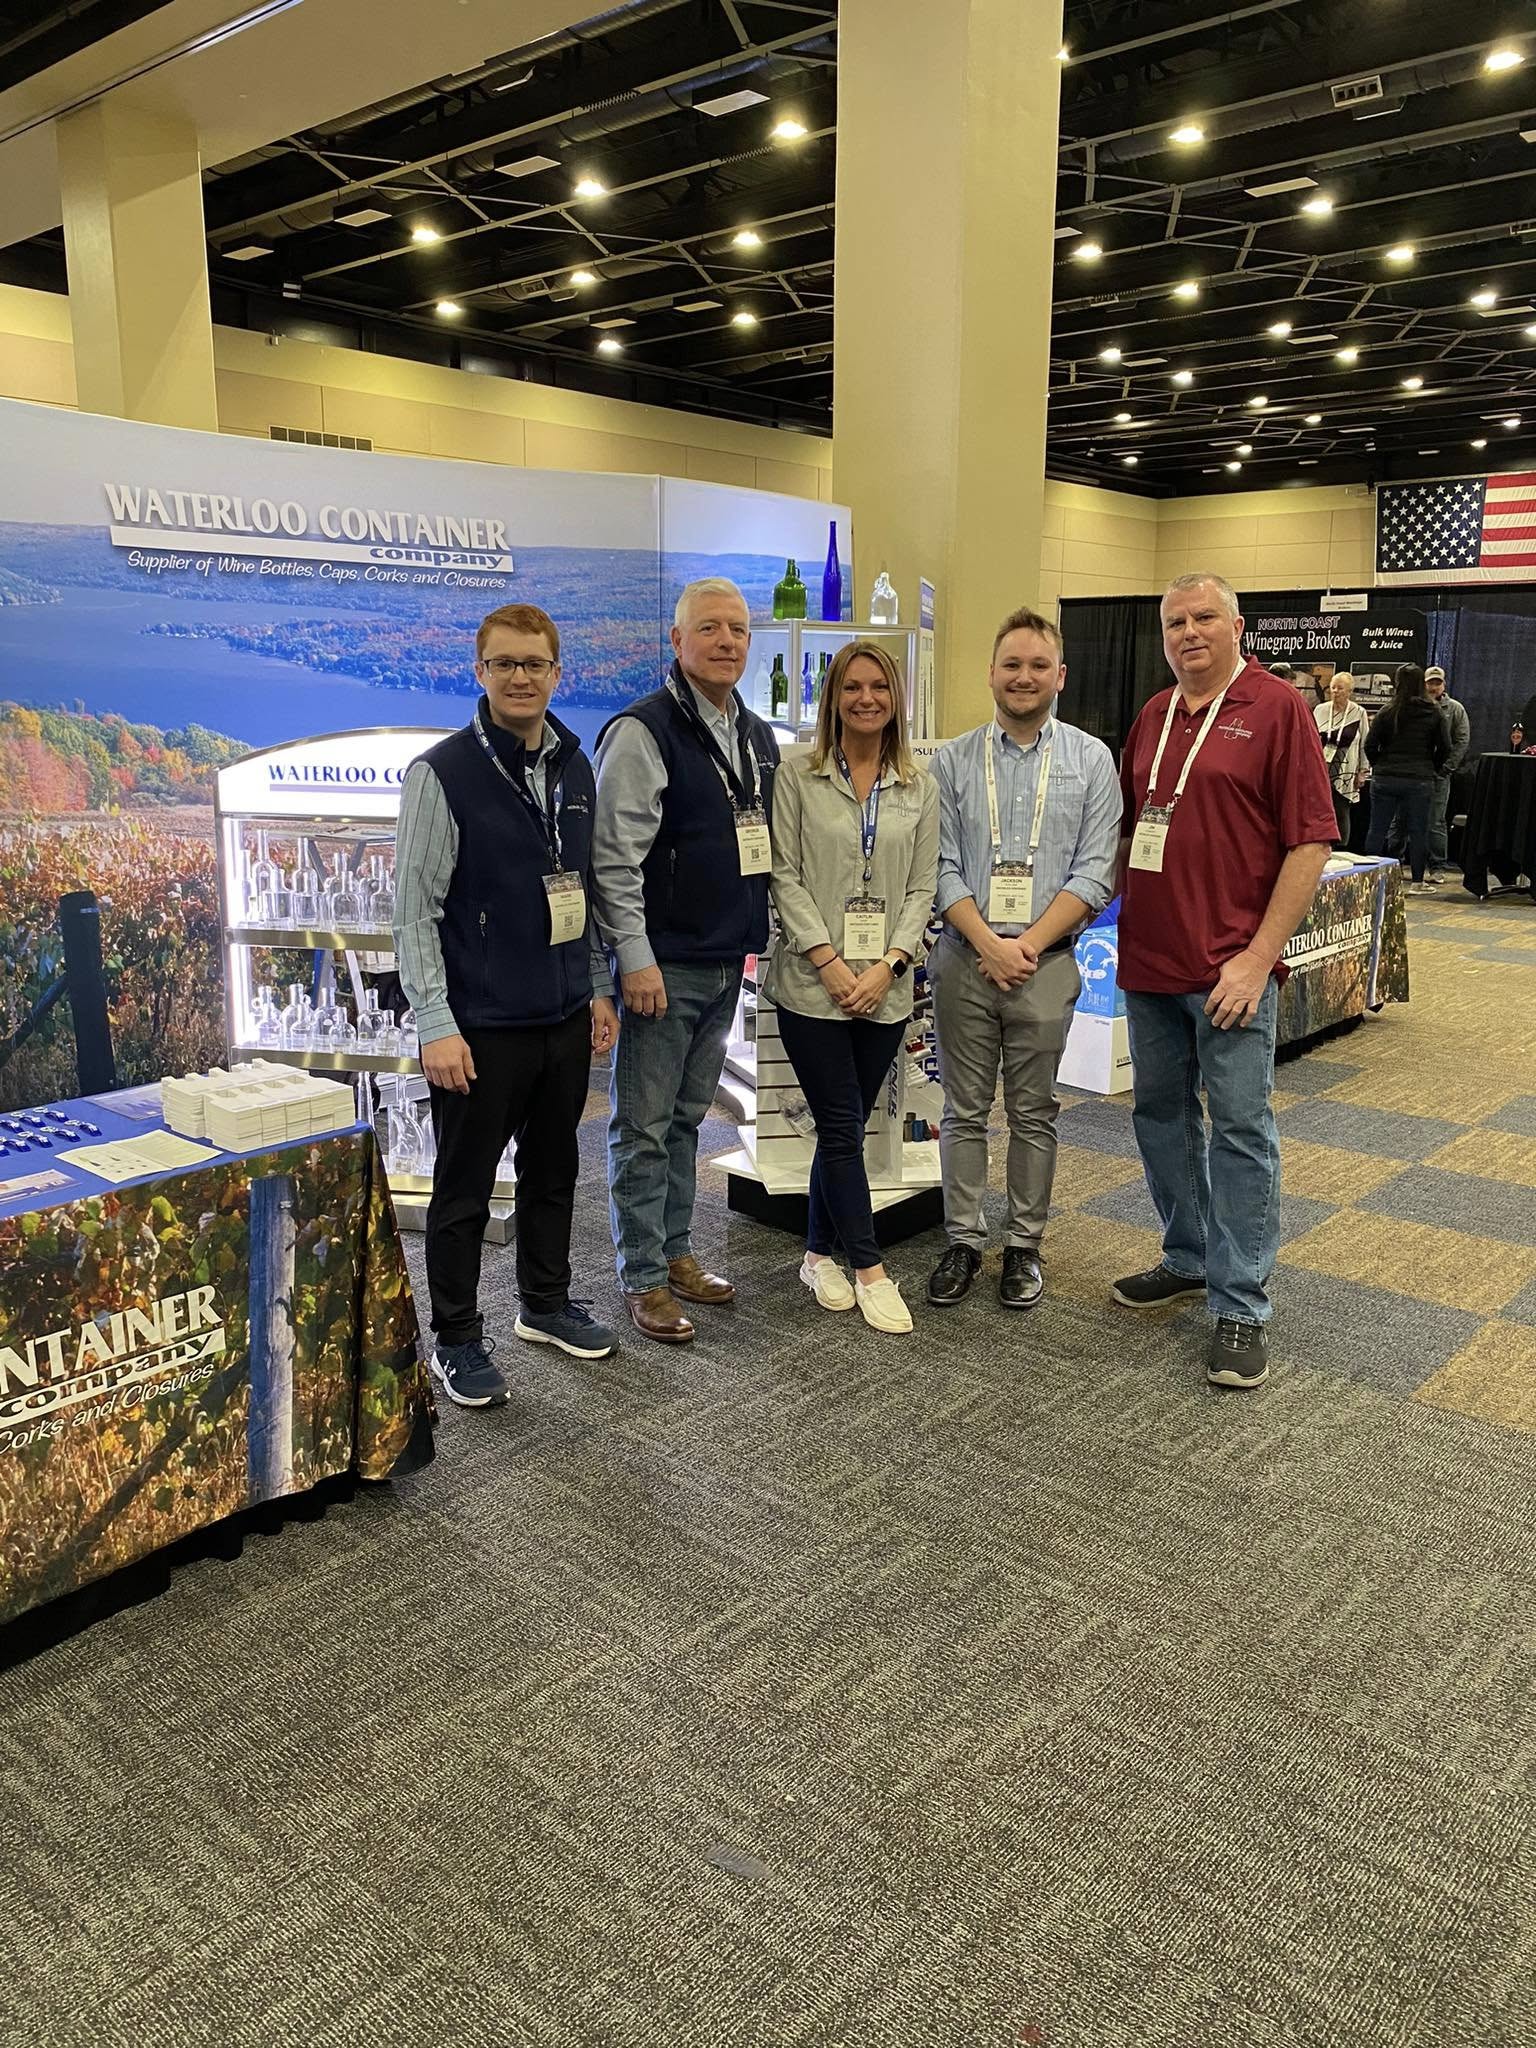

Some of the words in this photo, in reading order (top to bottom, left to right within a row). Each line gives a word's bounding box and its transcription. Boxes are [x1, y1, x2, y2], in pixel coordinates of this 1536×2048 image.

[103, 483, 308, 536] WATERLOO
[319, 504, 512, 551] CONTAINER
[127, 550, 193, 575] Supplier
[196, 557, 214, 576] of
[218, 556, 255, 574] Wine
[364, 566, 408, 583] Corks
[412, 571, 440, 585] and
[443, 572, 506, 588] Closures
[369, 547, 504, 569] company
[1257, 618, 1298, 631] NORTH
[1299, 616, 1341, 630] COAST
[1362, 627, 1384, 637] Bulk
[1385, 627, 1414, 637] Wines
[1245, 631, 1303, 655] Winegrape
[1306, 630, 1351, 650] Brokers
[1370, 640, 1379, 649] &
[1379, 640, 1404, 649] Juice
[268, 764, 376, 784] WATERLOO
[1281, 928, 1325, 957] ATERLOO
[1326, 914, 1372, 944] CONTAINER
[0, 1285, 223, 1395] NTAINER
[0, 1334, 213, 1418] company
[72, 1394, 117, 1426] and
[122, 1362, 214, 1409] Closures
